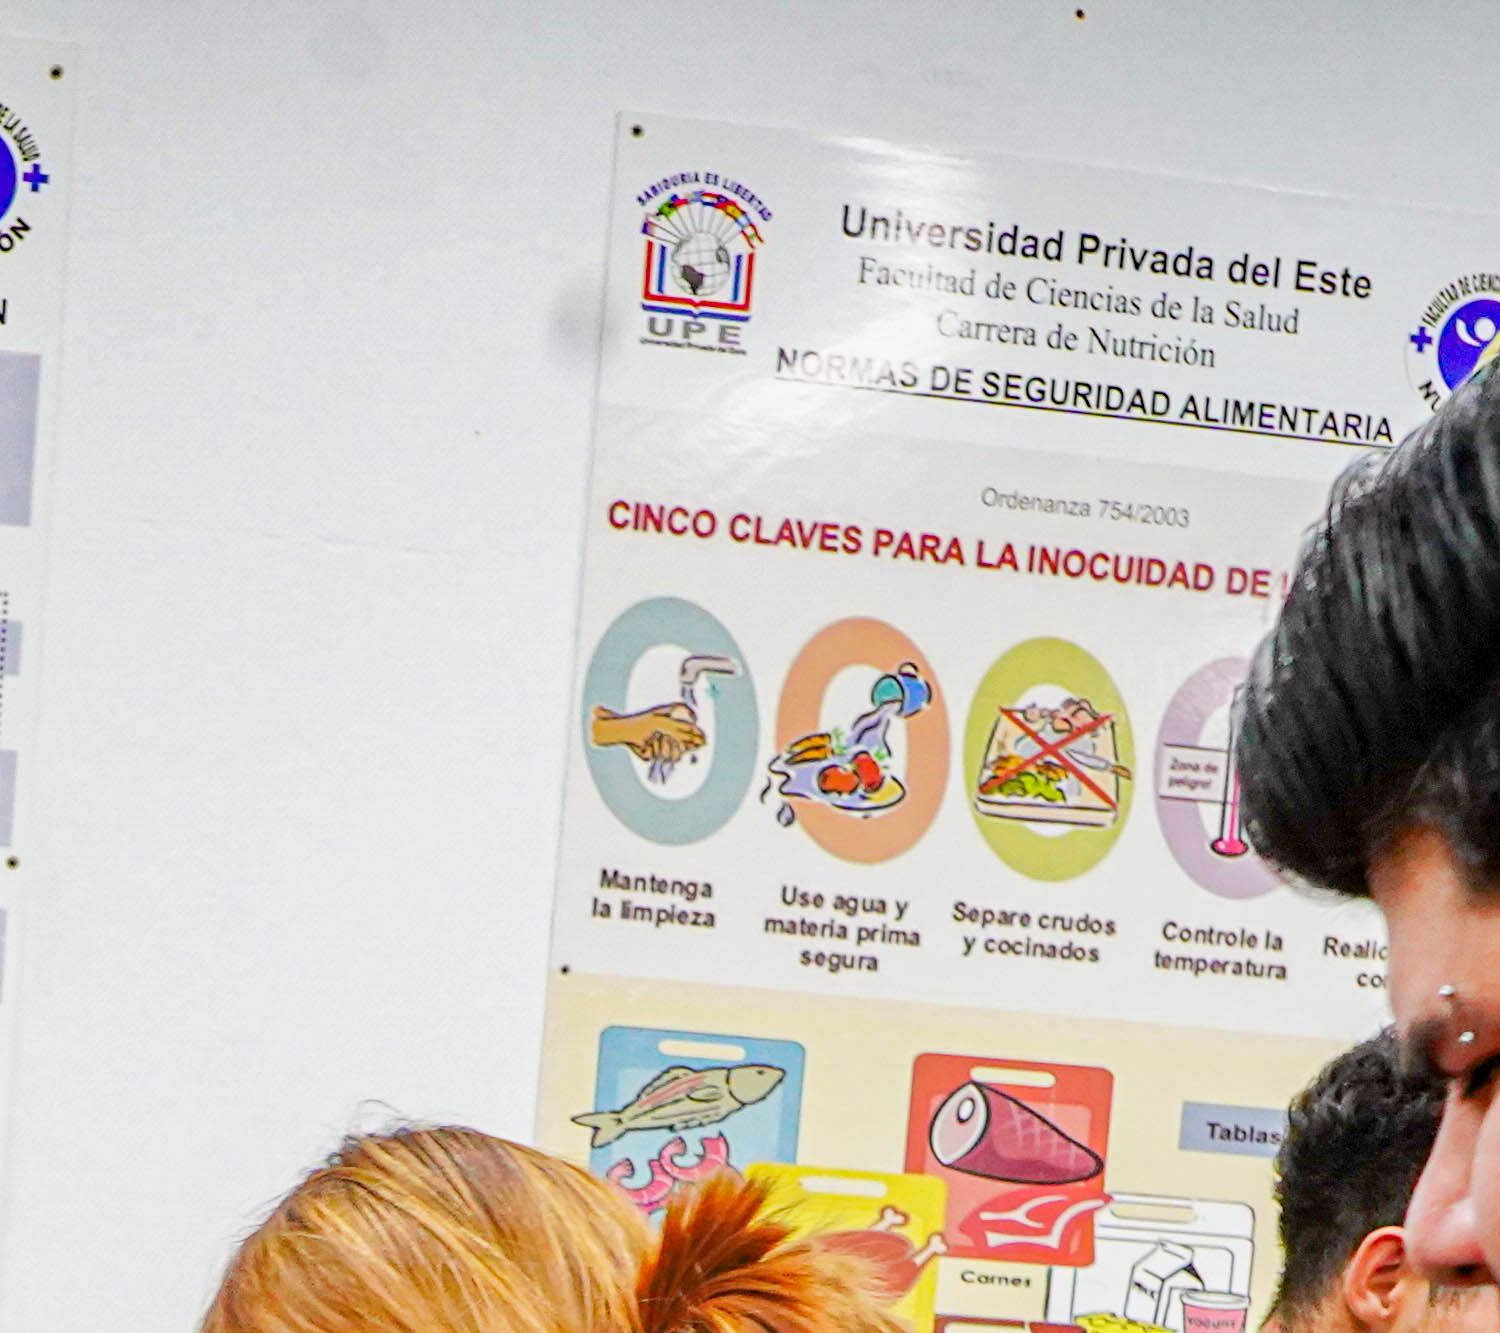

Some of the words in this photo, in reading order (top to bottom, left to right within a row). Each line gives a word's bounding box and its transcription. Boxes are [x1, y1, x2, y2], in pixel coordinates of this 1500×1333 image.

[842, 204, 1064, 263] Universidad
[1077, 233, 1214, 281] Privada
[1227, 253, 1281, 289] del
[1294, 259, 1372, 300] Este
[858, 255, 976, 296] Facultad
[984, 271, 1017, 301] de
[1025, 276, 1142, 317] Ciencias
[1150, 291, 1183, 321] de
[1192, 295, 1214, 325] la
[1223, 300, 1300, 335] Salud
[649, 317, 741, 344] UPE
[937, 315, 1037, 347] Carrera
[1045, 322, 1079, 352] de
[1088, 326, 1215, 369] Nutrición
[776, 347, 918, 389] NORMAS
[931, 366, 973, 395] DE
[981, 371, 1171, 417] SEGURIDAD
[1179, 394, 1393, 443] ALIMENTARIA
[607, 499, 718, 539] CINCO
[728, 513, 863, 555] CLAVES
[872, 528, 966, 566] PARA
[975, 539, 1020, 572] LA
[1027, 544, 1215, 592] INOCUIDAD
[1225, 567, 1272, 598] DE
[599, 868, 714, 901] Mantenga
[591, 896, 612, 919] la
[620, 898, 716, 928] limpieza
[781, 885, 824, 908] Use
[833, 892, 887, 917] agua
[896, 900, 908, 921] y
[952, 901, 1033, 934] Separe
[1037, 913, 1117, 936] crudos
[764, 916, 848, 940] materia
[856, 926, 921, 947] prima
[1161, 920, 1259, 949] Controle
[1264, 930, 1284, 952] la
[799, 950, 879, 974] segura
[962, 936, 977, 957] y
[983, 936, 1100, 963] cocinados
[1153, 949, 1287, 980] temperatura
[1207, 1122, 1281, 1145] Tablas
[960, 1270, 1031, 1288] Carnes
